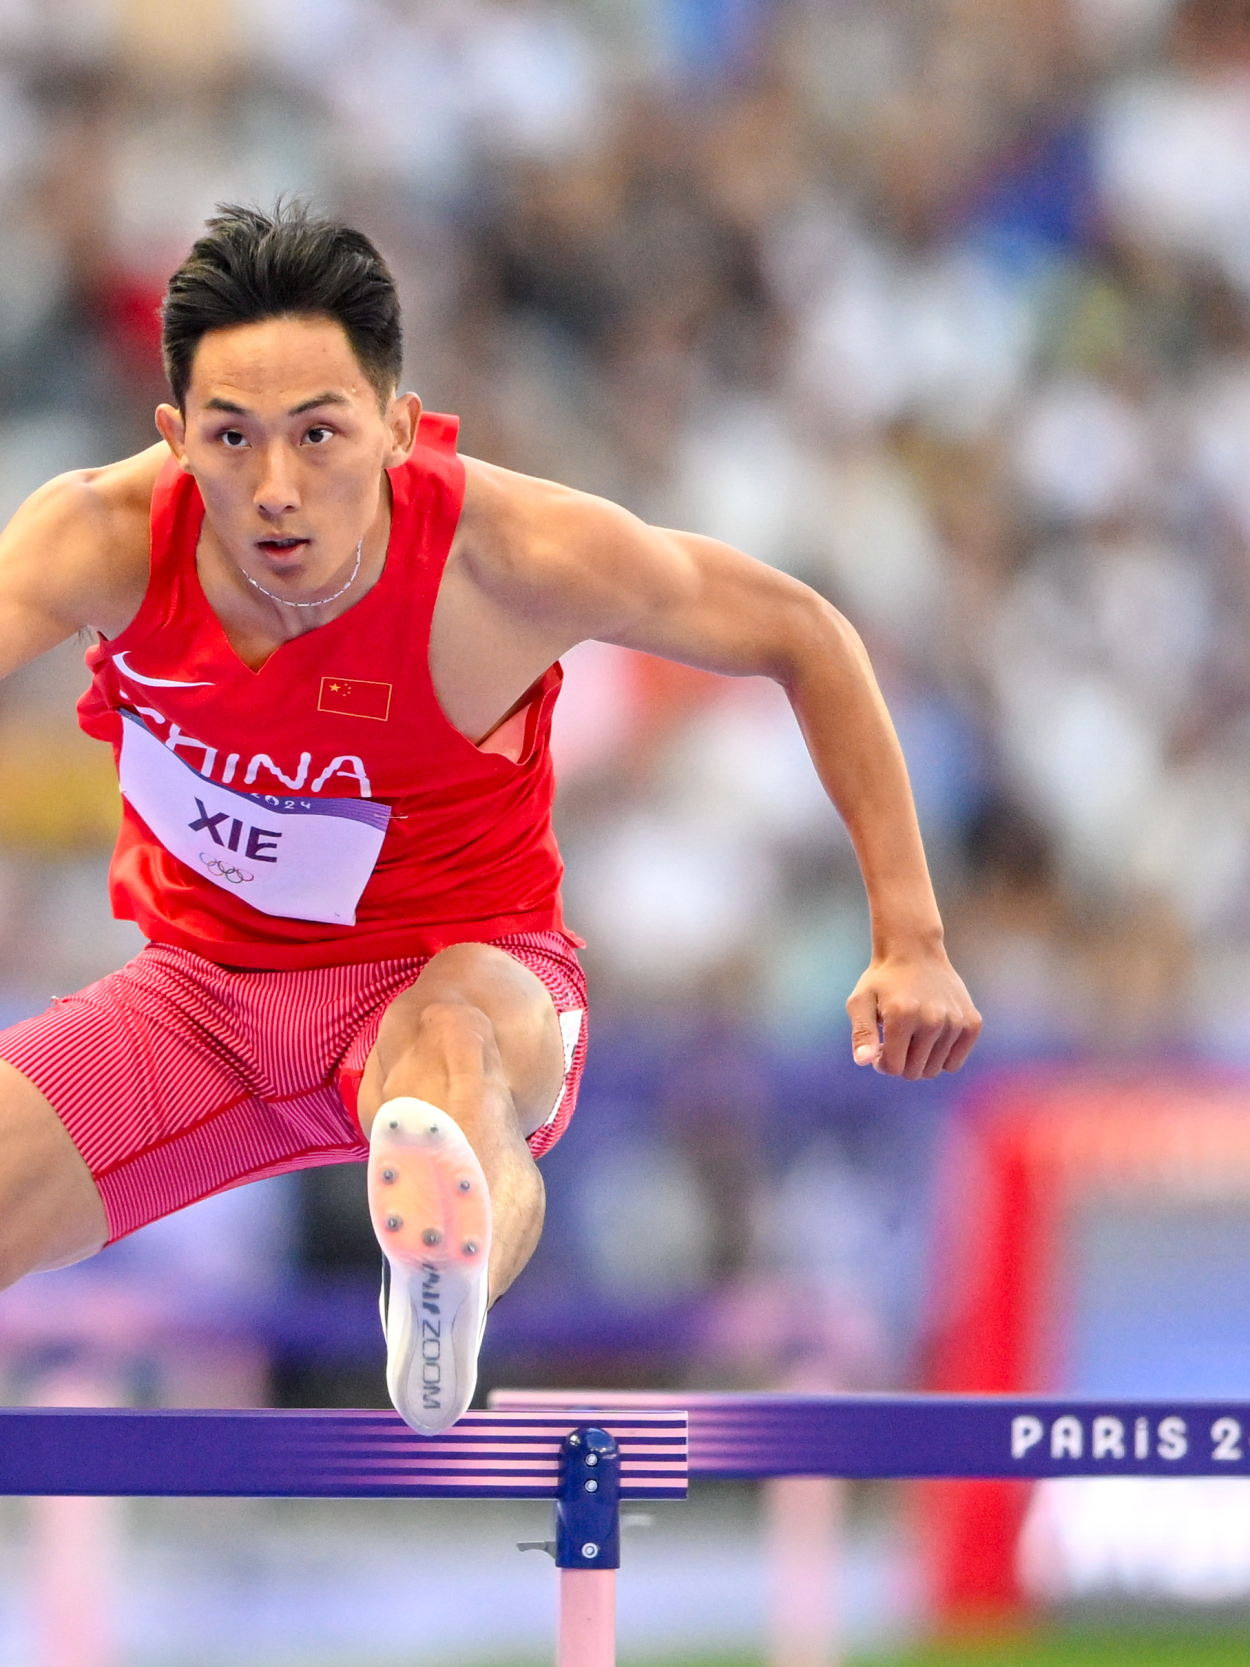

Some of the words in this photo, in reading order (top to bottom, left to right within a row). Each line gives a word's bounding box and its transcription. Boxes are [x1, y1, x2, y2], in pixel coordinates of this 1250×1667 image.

[188, 796, 282, 863] XIE
[422, 1319, 441, 1409] ZOOM
[1210, 1415, 1250, 1461] 2
